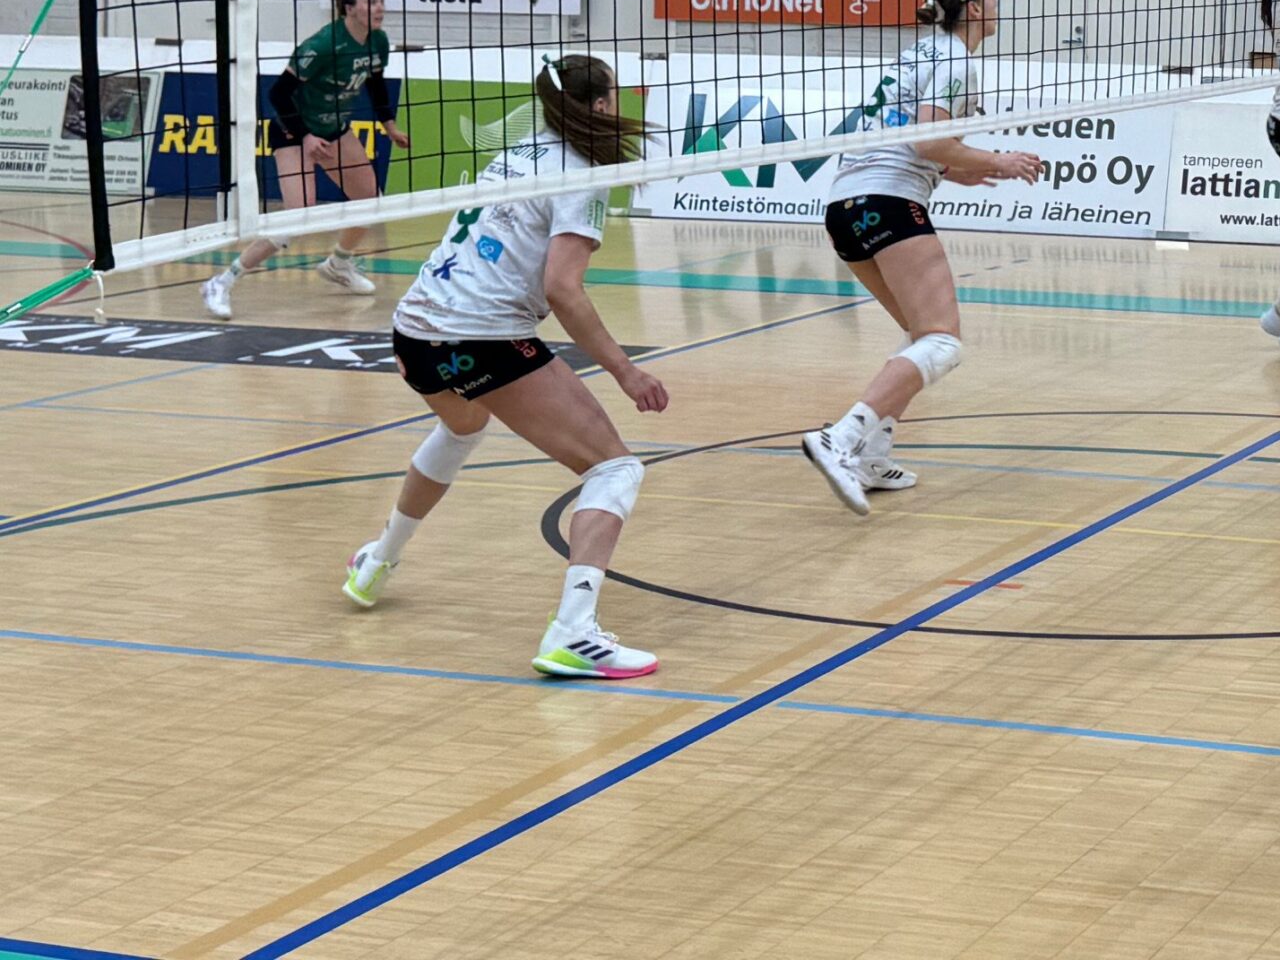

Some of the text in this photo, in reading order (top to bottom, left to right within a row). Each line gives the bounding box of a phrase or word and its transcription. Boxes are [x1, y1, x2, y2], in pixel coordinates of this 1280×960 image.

[1106, 154, 1155, 195] Oy
[1183, 153, 1263, 170] tampereen
[1007, 200, 1034, 222] ja
[1041, 200, 1152, 226] läheinen
[436, 351, 475, 381] EVO
